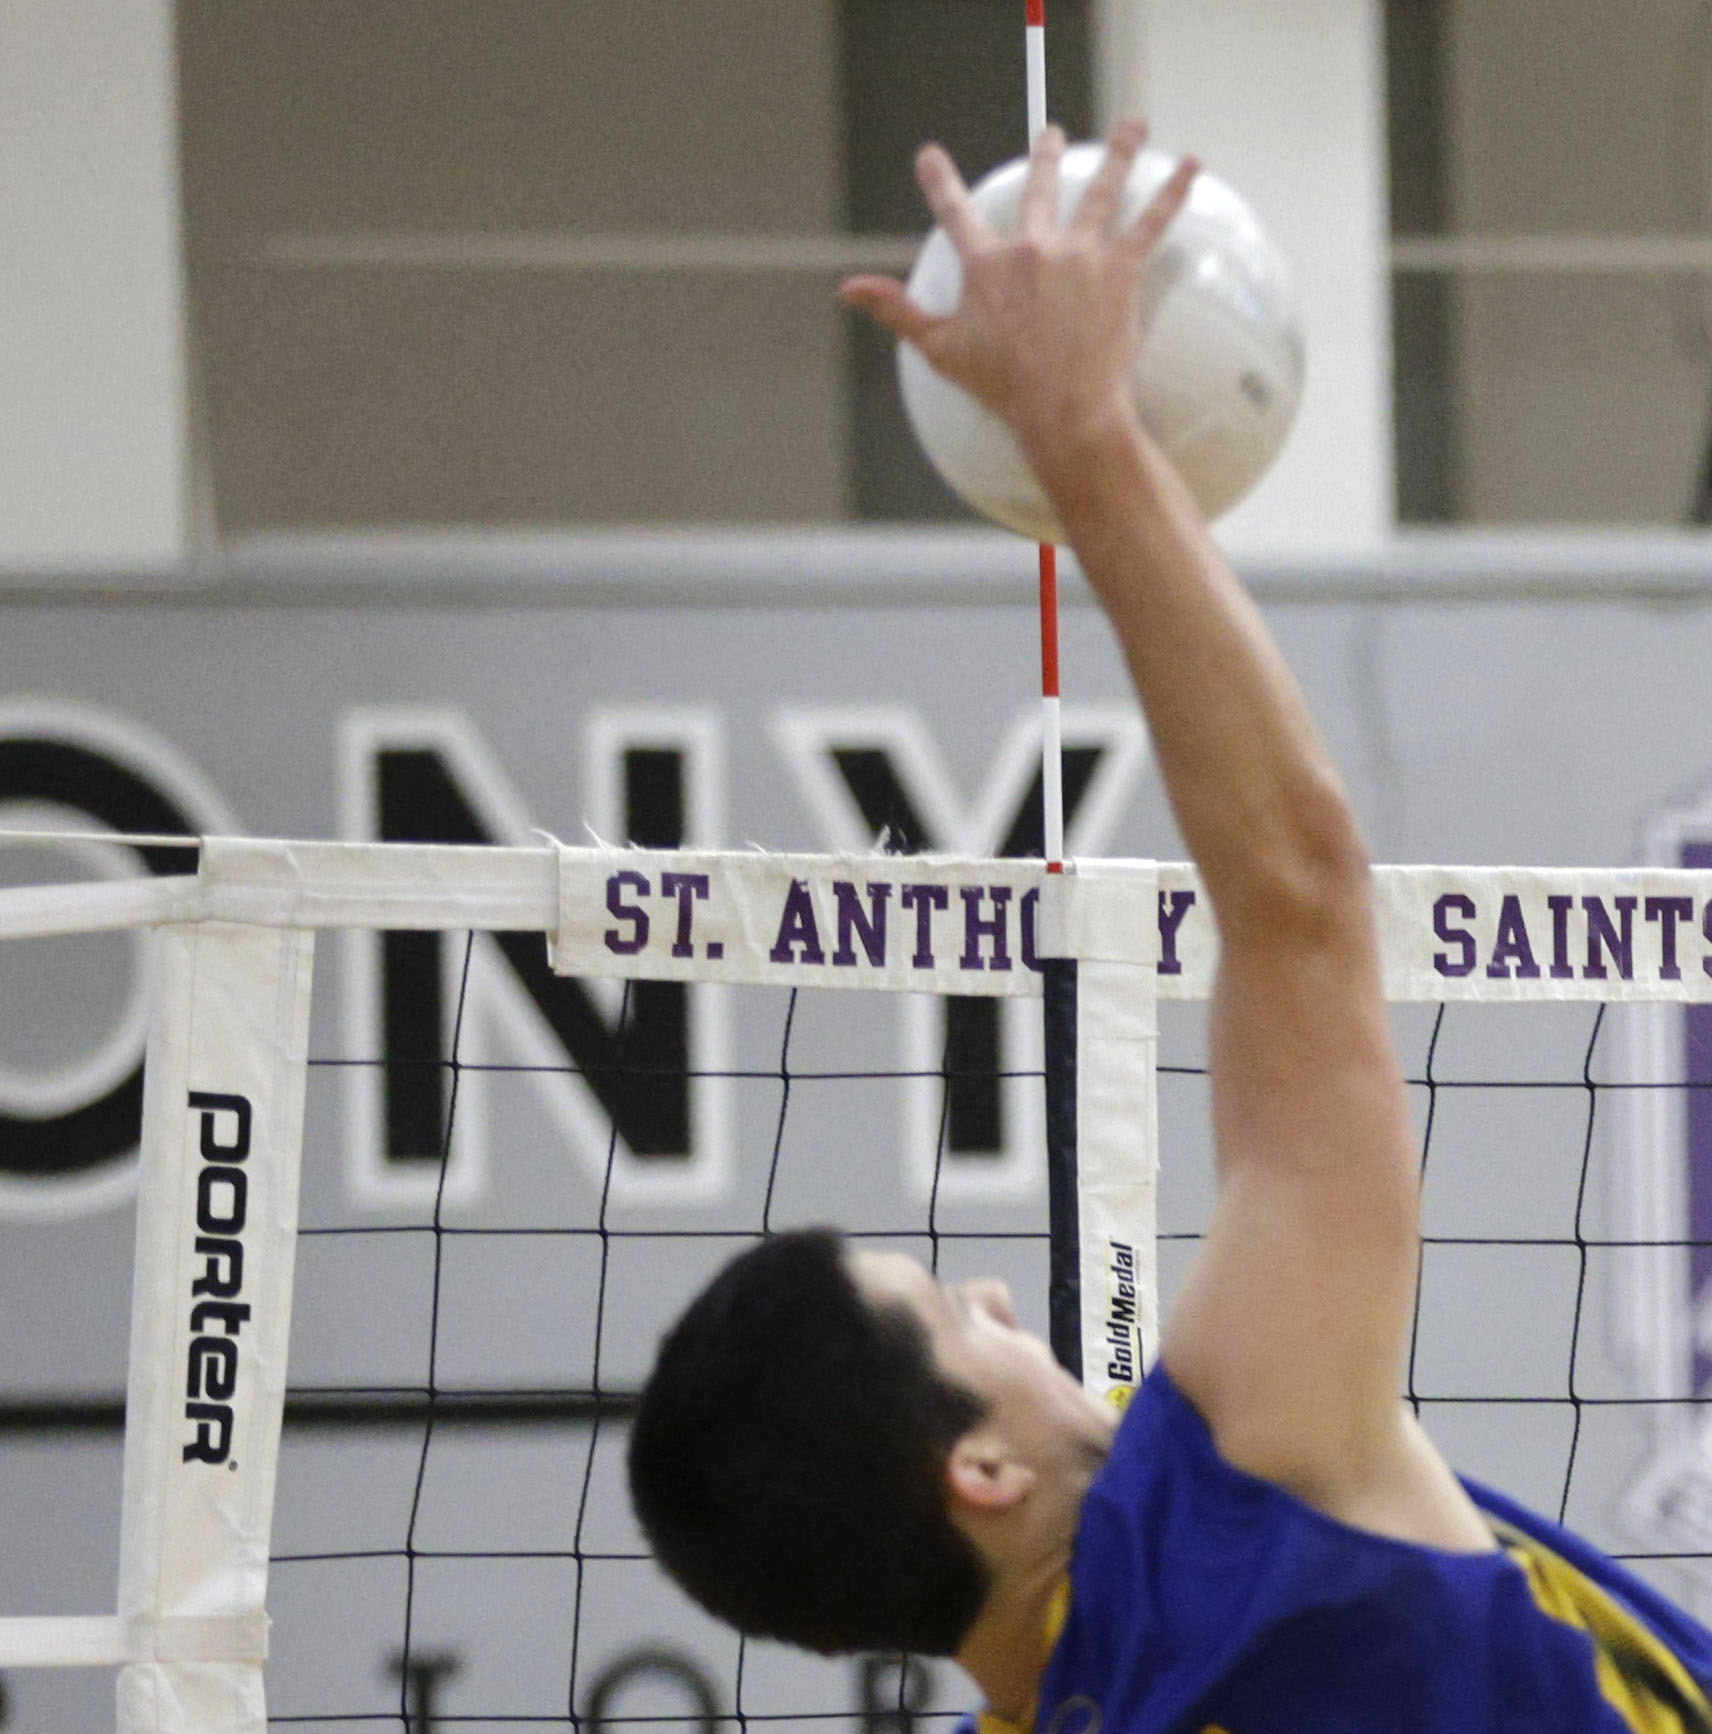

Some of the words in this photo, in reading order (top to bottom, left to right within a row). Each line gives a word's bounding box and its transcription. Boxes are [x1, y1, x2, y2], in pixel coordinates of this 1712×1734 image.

[604, 871, 723, 959] ST.
[769, 877, 1196, 975] ANTHY
[1106, 1241, 1136, 1383] GoldMedal
